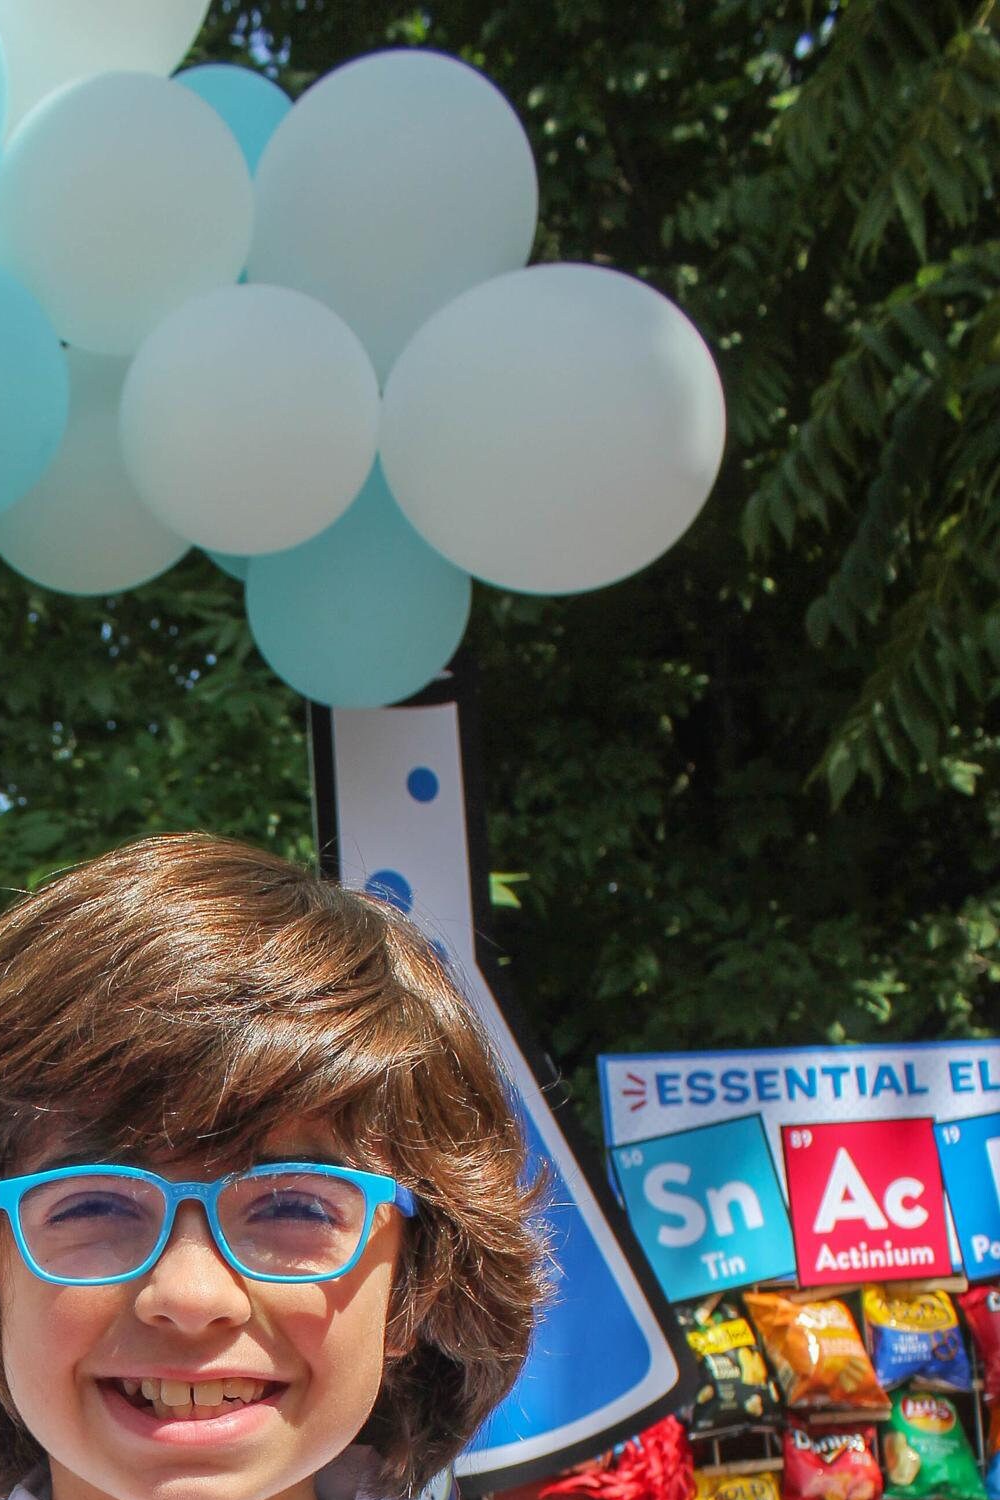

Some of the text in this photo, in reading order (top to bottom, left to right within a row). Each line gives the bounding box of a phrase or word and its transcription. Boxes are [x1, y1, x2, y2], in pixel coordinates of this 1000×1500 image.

[655, 1058, 1000, 1107] ESSENTIAL EL
[788, 1129, 814, 1149] 89
[942, 1125, 961, 1145] 19
[643, 1162, 764, 1248] Sn
[813, 1147, 929, 1234] Ac
[701, 1252, 747, 1280] Tin
[815, 1239, 935, 1272] Actinium
